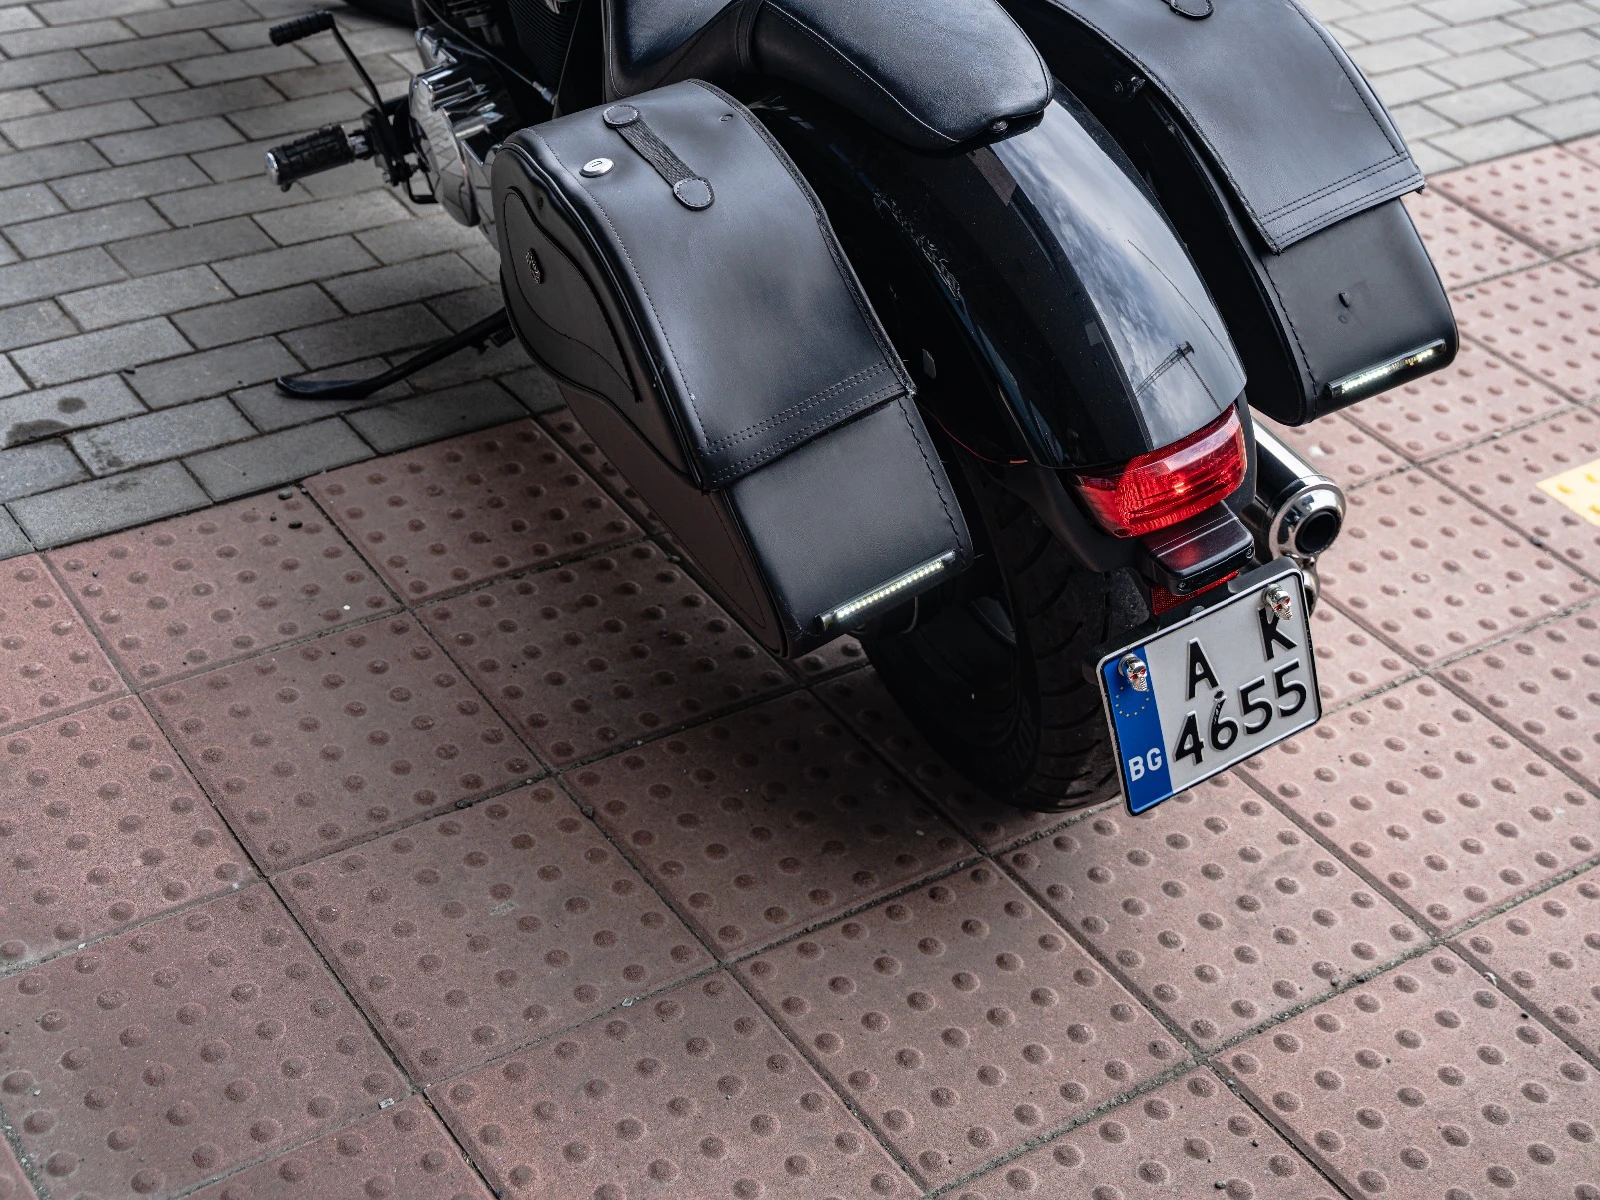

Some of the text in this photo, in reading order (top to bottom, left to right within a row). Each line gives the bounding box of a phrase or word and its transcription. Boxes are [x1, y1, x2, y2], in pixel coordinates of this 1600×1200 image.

[1185, 604, 1298, 702] A K
[1173, 658, 1308, 766] 4655
[1128, 747, 1163, 782] BG
